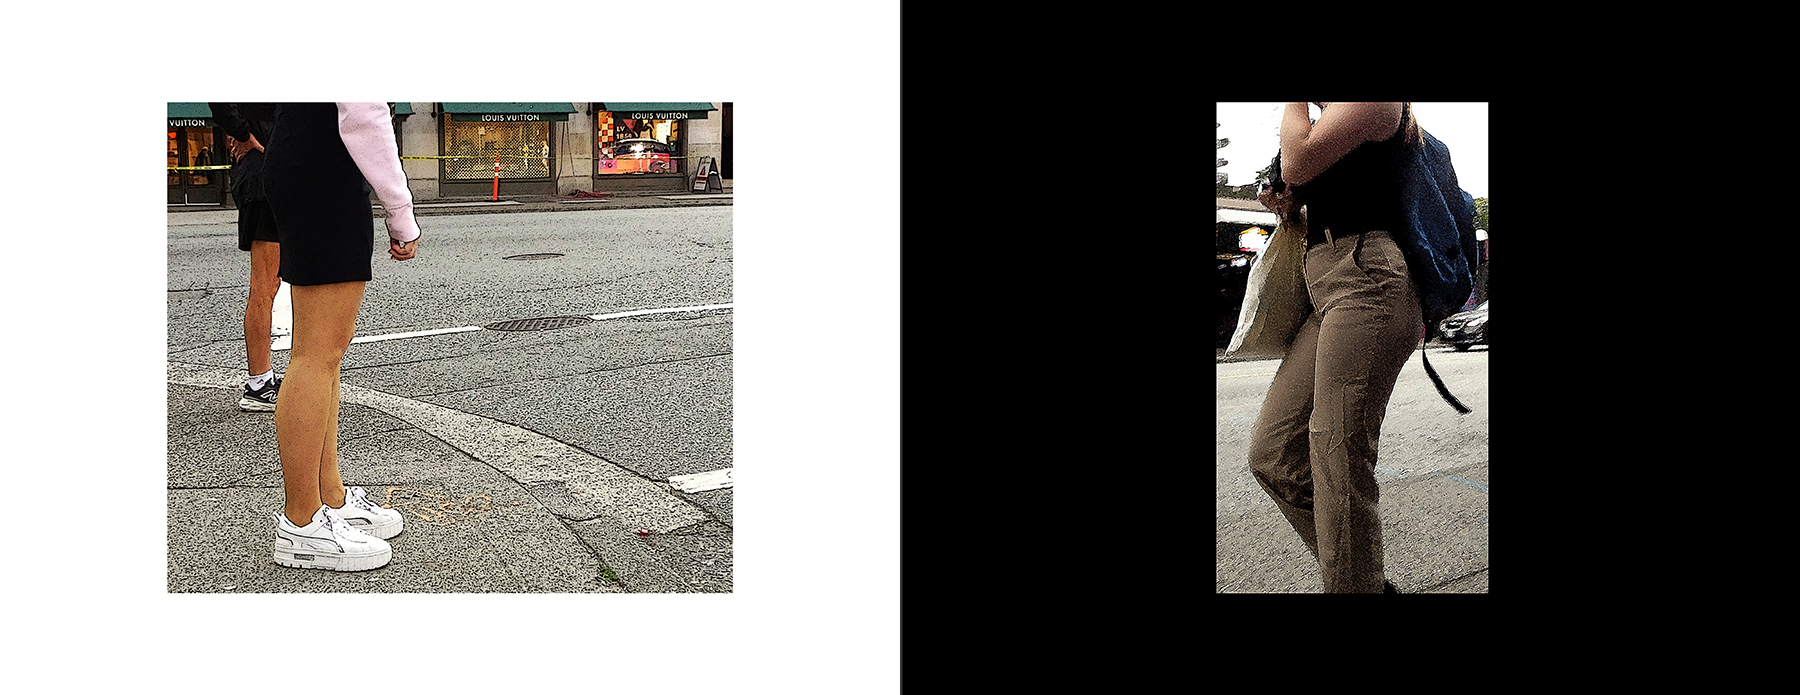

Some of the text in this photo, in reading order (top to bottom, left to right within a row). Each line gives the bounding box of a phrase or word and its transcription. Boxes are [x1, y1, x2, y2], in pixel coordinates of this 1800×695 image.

[482, 114, 540, 122] LOUIS VUITTON
[632, 112, 688, 120] LOUIS VUITTON
[169, 119, 206, 127] VUITTON
